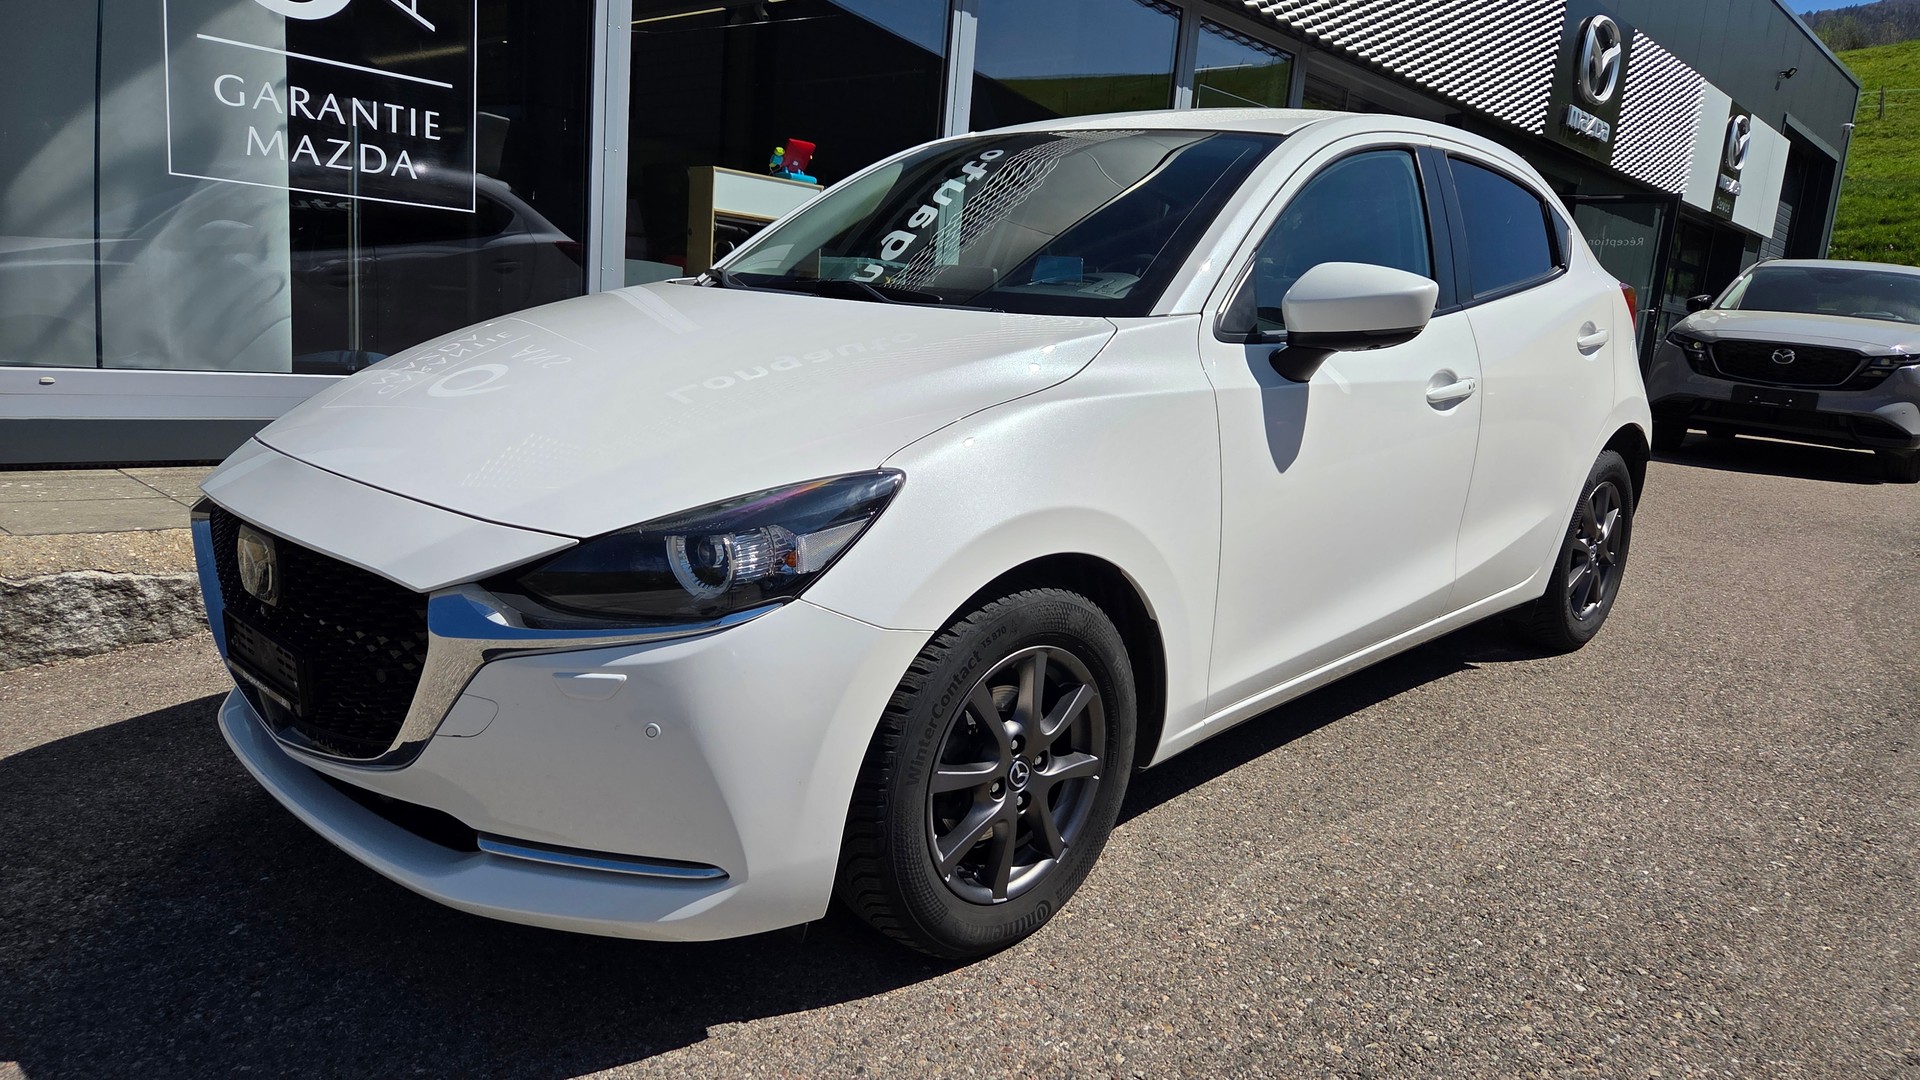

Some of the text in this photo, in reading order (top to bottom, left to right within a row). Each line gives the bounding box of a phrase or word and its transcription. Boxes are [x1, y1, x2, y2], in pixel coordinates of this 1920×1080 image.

[213, 74, 441, 140] GARANTIE
[246, 126, 418, 180] MAZDA
[906, 626, 1007, 786] WinterContact TS 870
